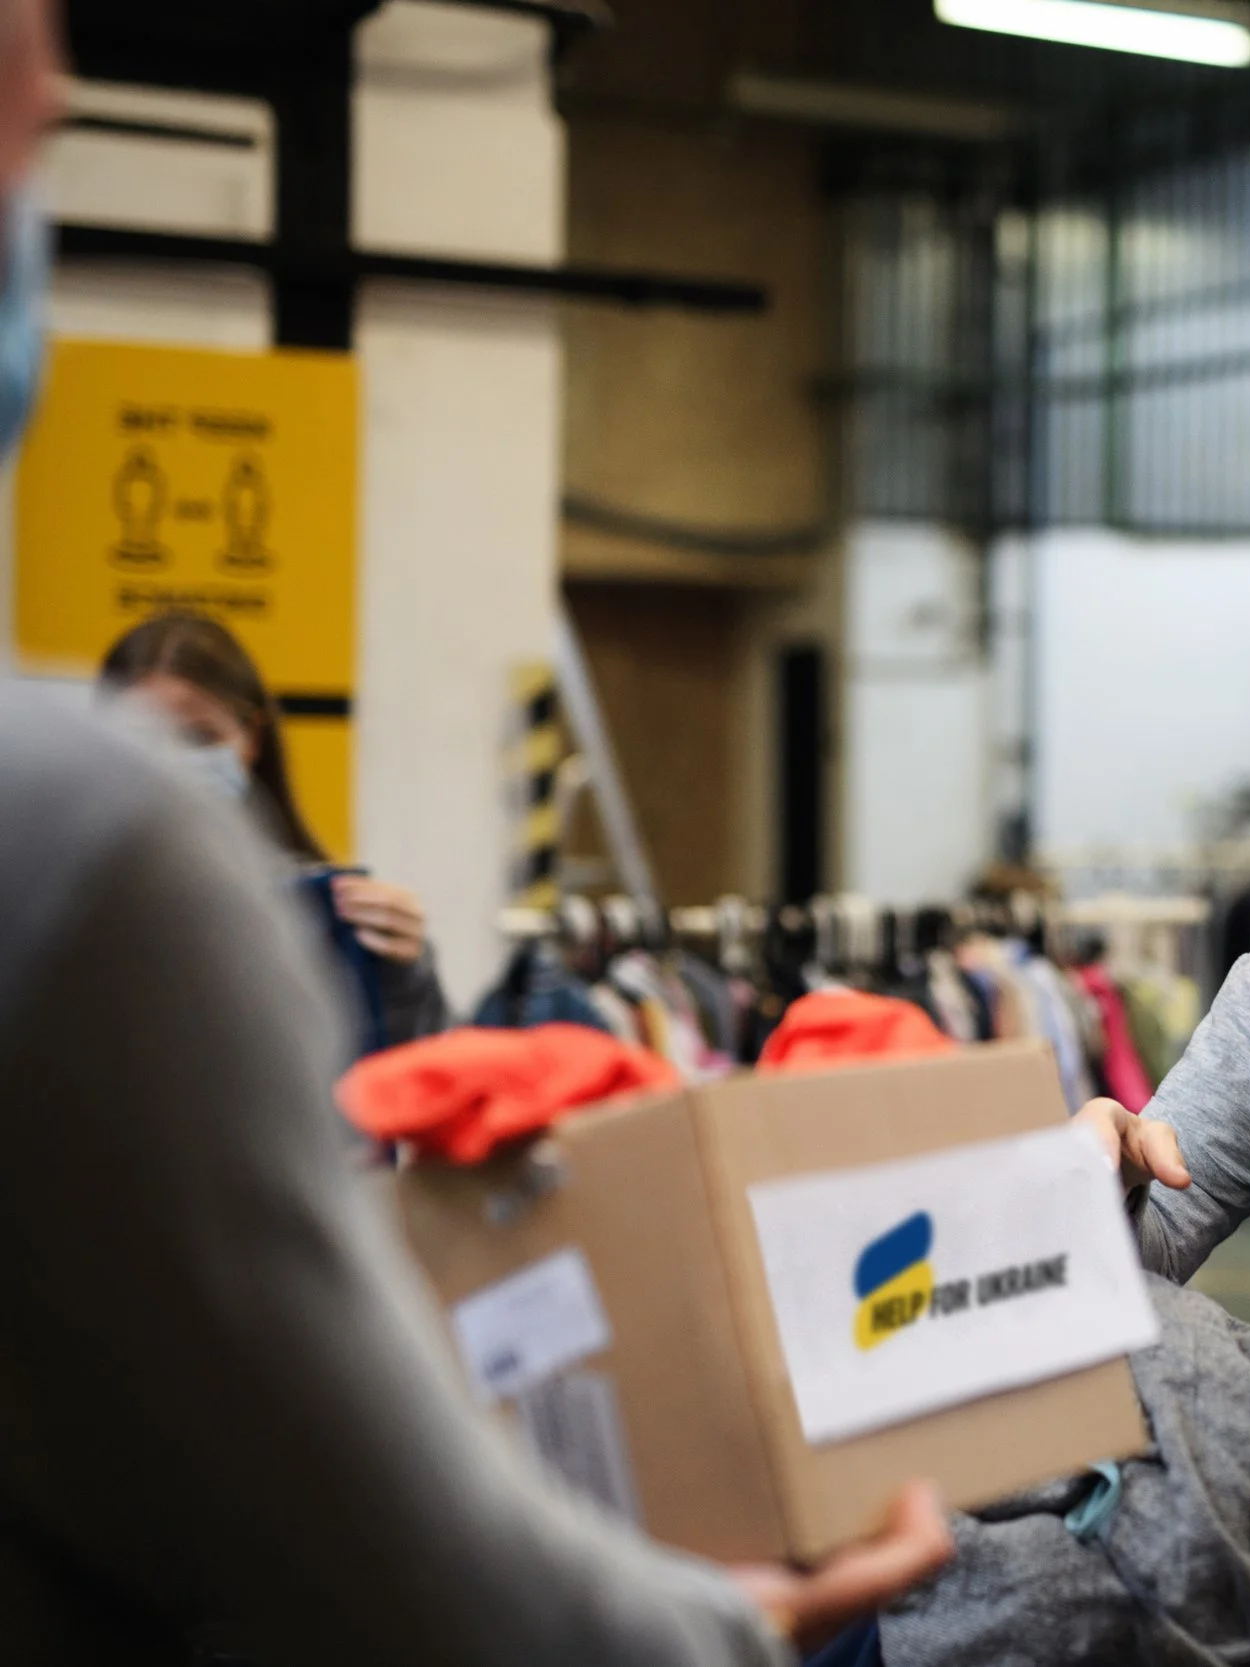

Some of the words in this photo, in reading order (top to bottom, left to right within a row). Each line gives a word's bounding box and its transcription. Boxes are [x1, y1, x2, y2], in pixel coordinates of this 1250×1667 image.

[871, 1290, 925, 1333] HELP
[930, 1279, 970, 1318] FOR
[977, 1253, 1067, 1305] UKRAINE
